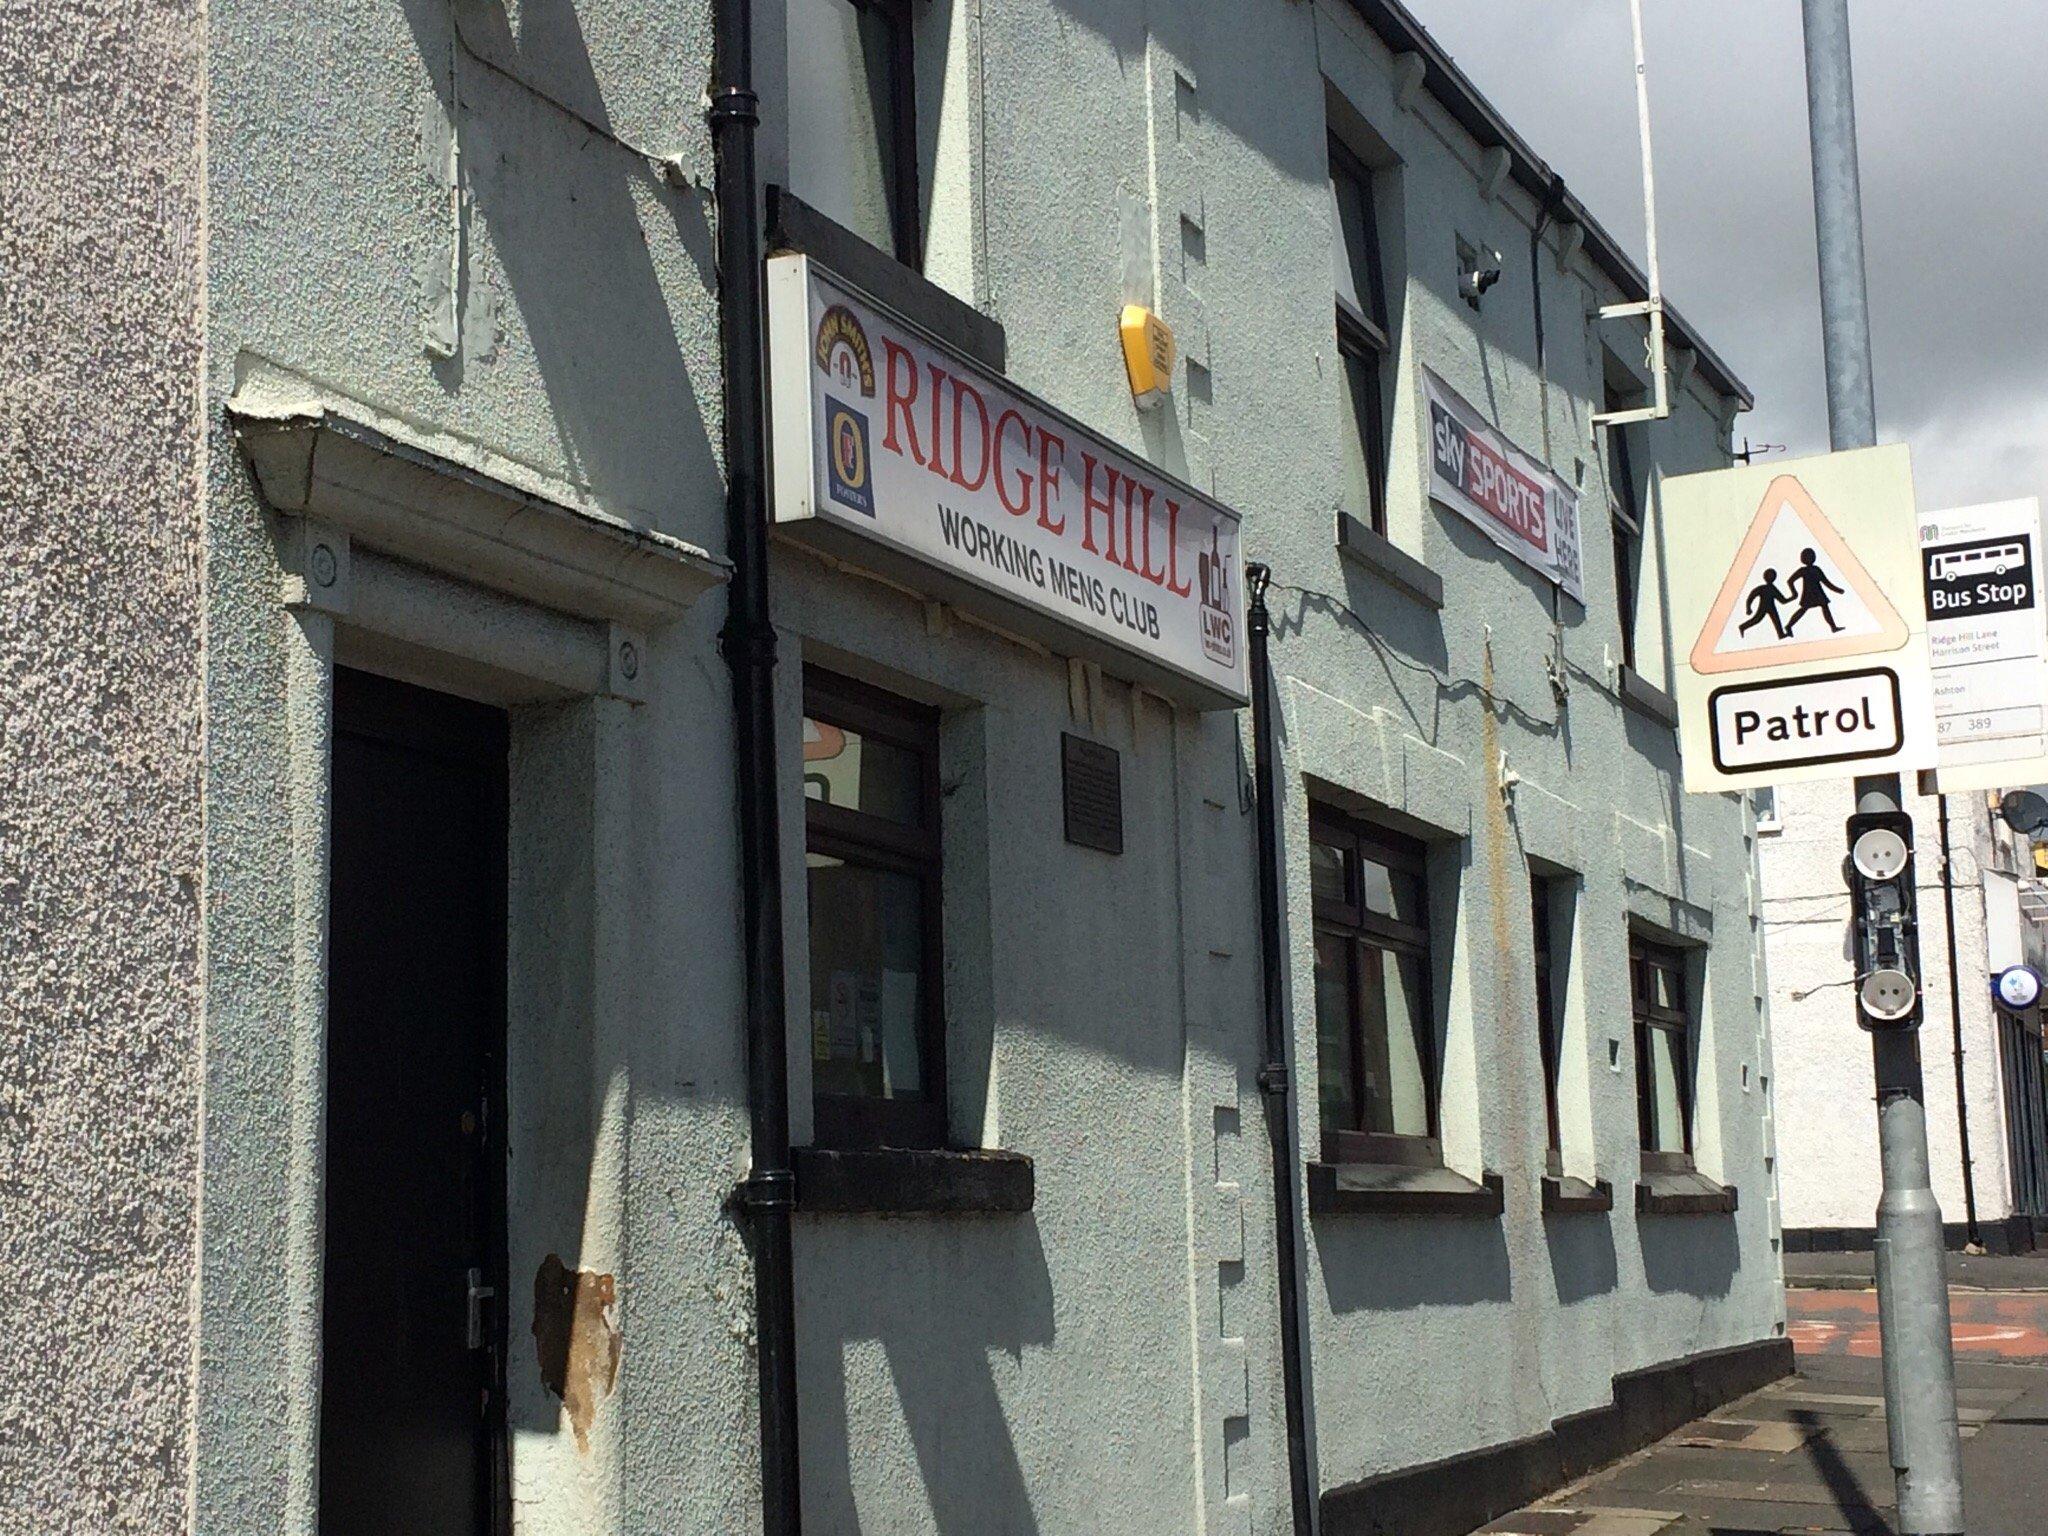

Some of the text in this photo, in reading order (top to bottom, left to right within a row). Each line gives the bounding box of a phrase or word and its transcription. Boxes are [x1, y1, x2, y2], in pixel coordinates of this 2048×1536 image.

[881, 335, 1191, 598] RIDGE HILL
[1469, 448, 1543, 540] SPORTS
[938, 503, 1161, 640] WORKING MENS CLUB
[1932, 583, 2027, 610] Bus Stop
[1203, 611, 1230, 644] LWC
[1931, 630, 1998, 646] Ridge Hill Lane
[1972, 641, 2000, 652] Street
[1734, 696, 1876, 746] Patrol
[1968, 717, 1992, 731] 389
